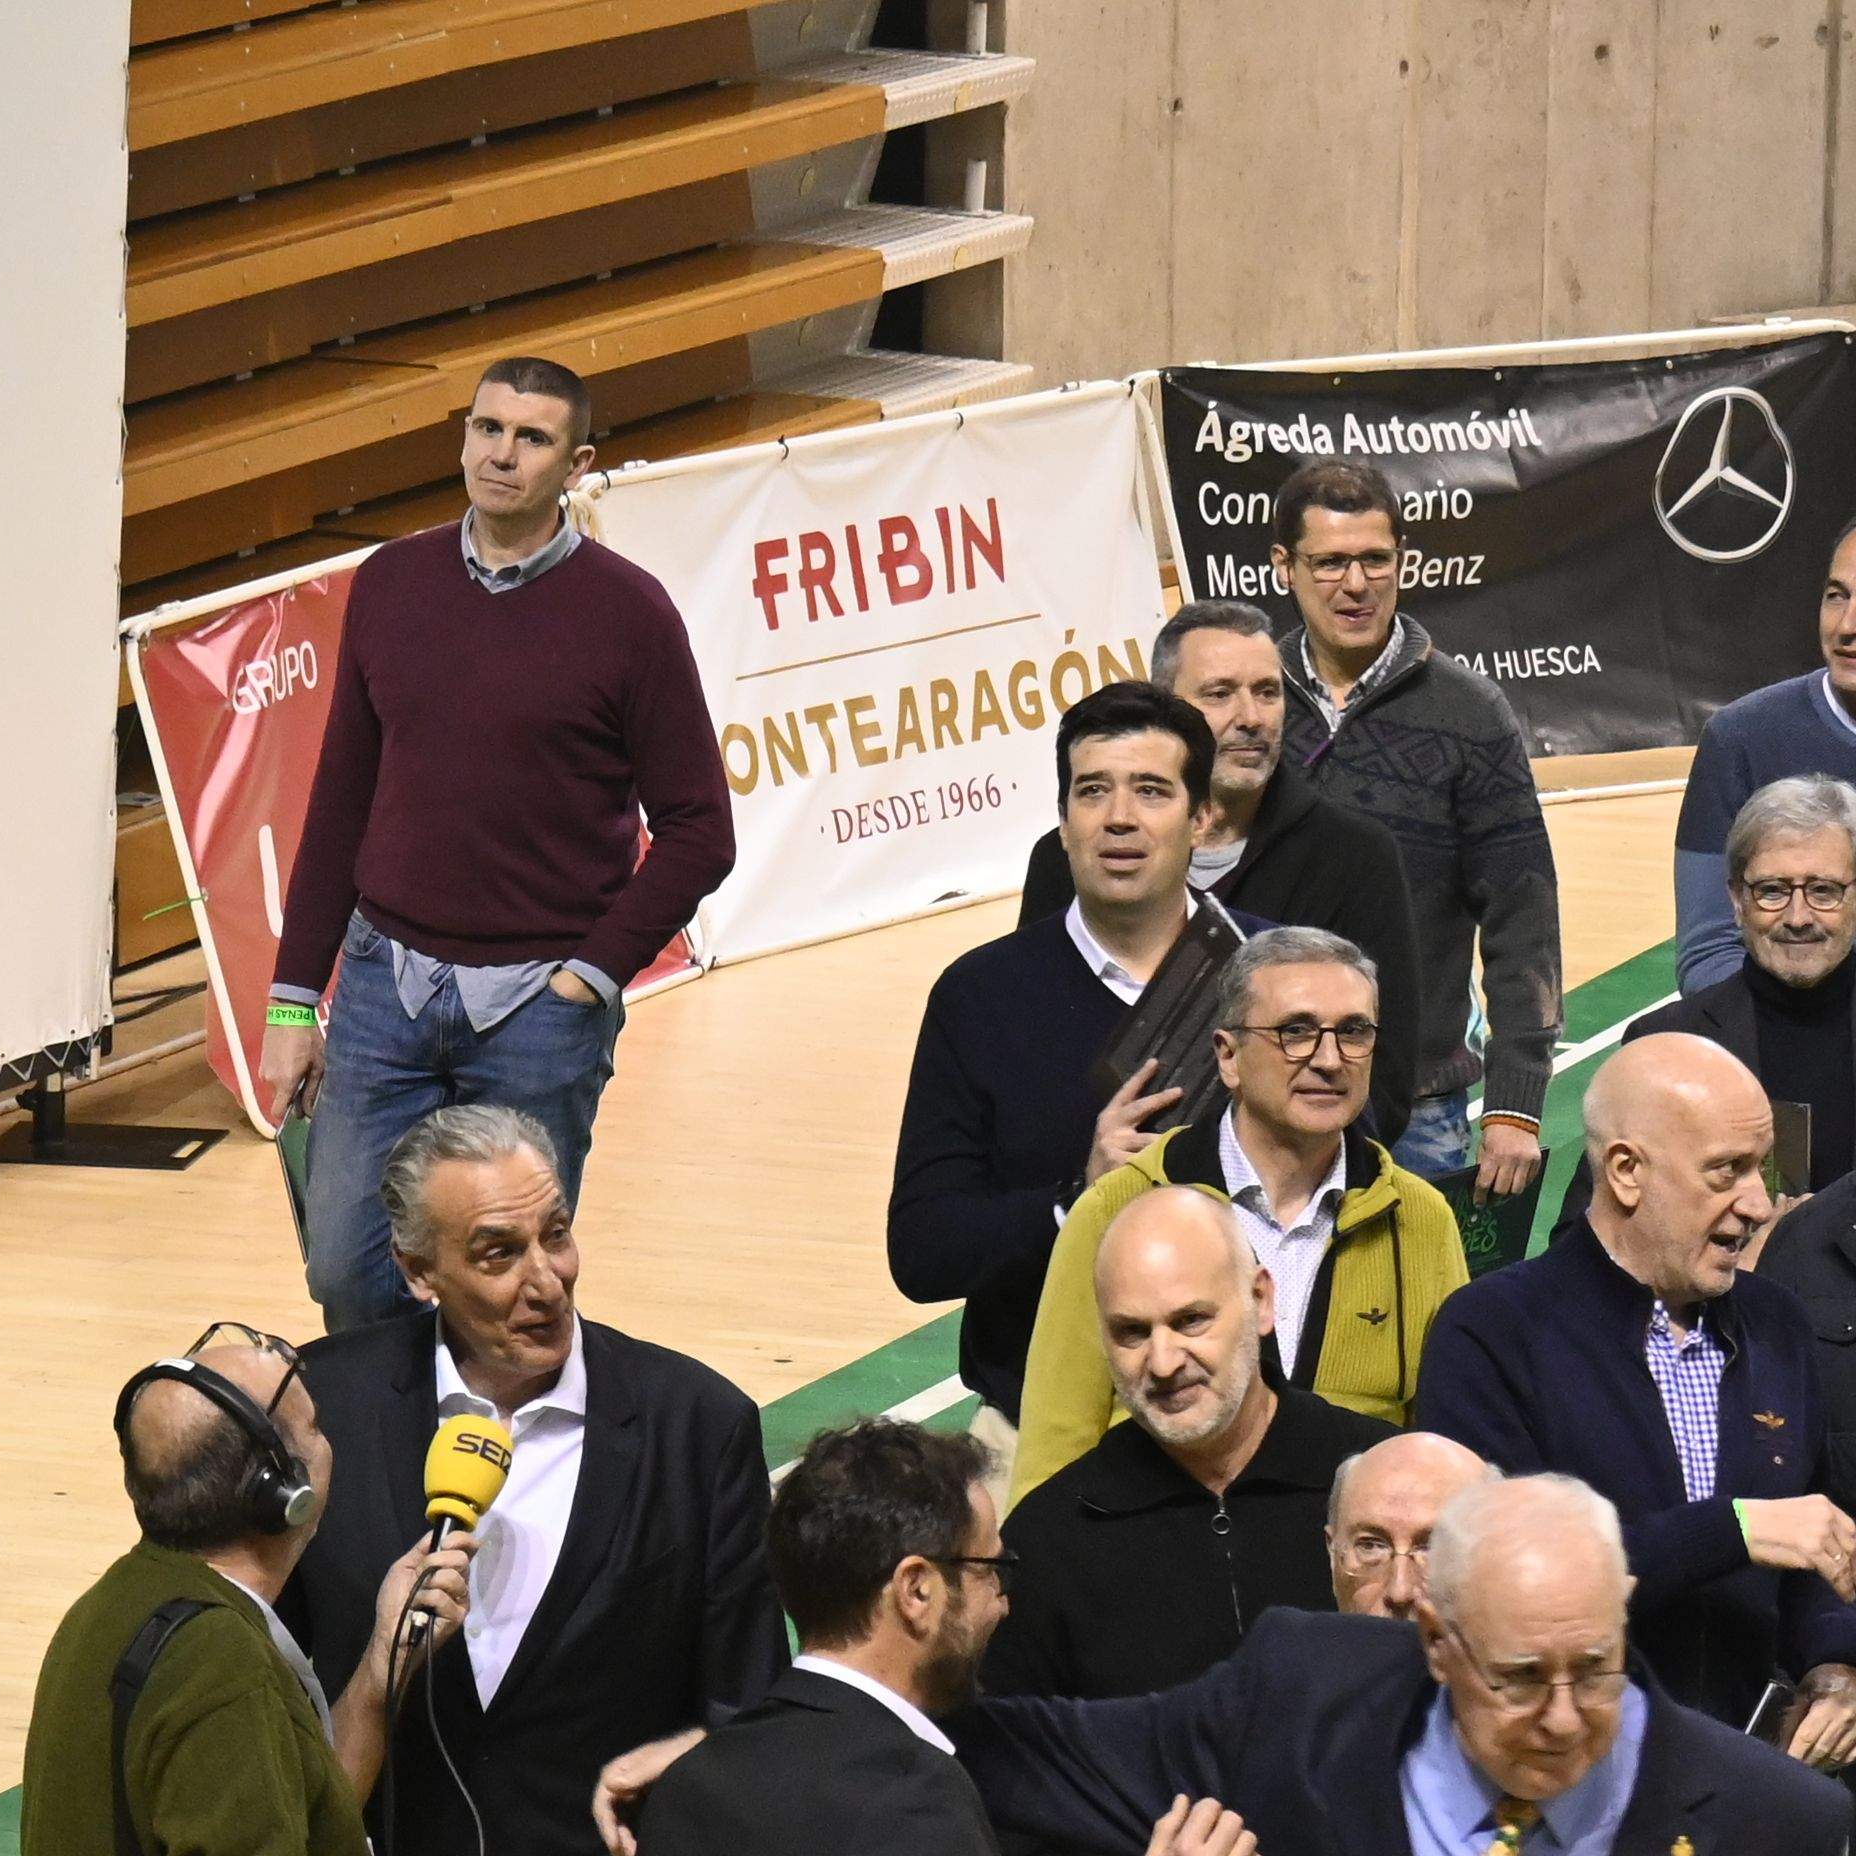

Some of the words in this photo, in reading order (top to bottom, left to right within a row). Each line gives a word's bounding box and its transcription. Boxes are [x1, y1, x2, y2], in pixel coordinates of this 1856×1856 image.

[1196, 405, 1334, 462] Ágreda
[1344, 407, 1541, 455] Automóvil
[752, 497, 1006, 631] FRIBIN
[232, 640, 318, 715] GRUPO
[1494, 644, 1602, 680] HUESCA
[721, 630, 1146, 797] ONTEARAGÓN
[832, 790, 930, 844] DESDE
[936, 774, 1002, 820] 1966
